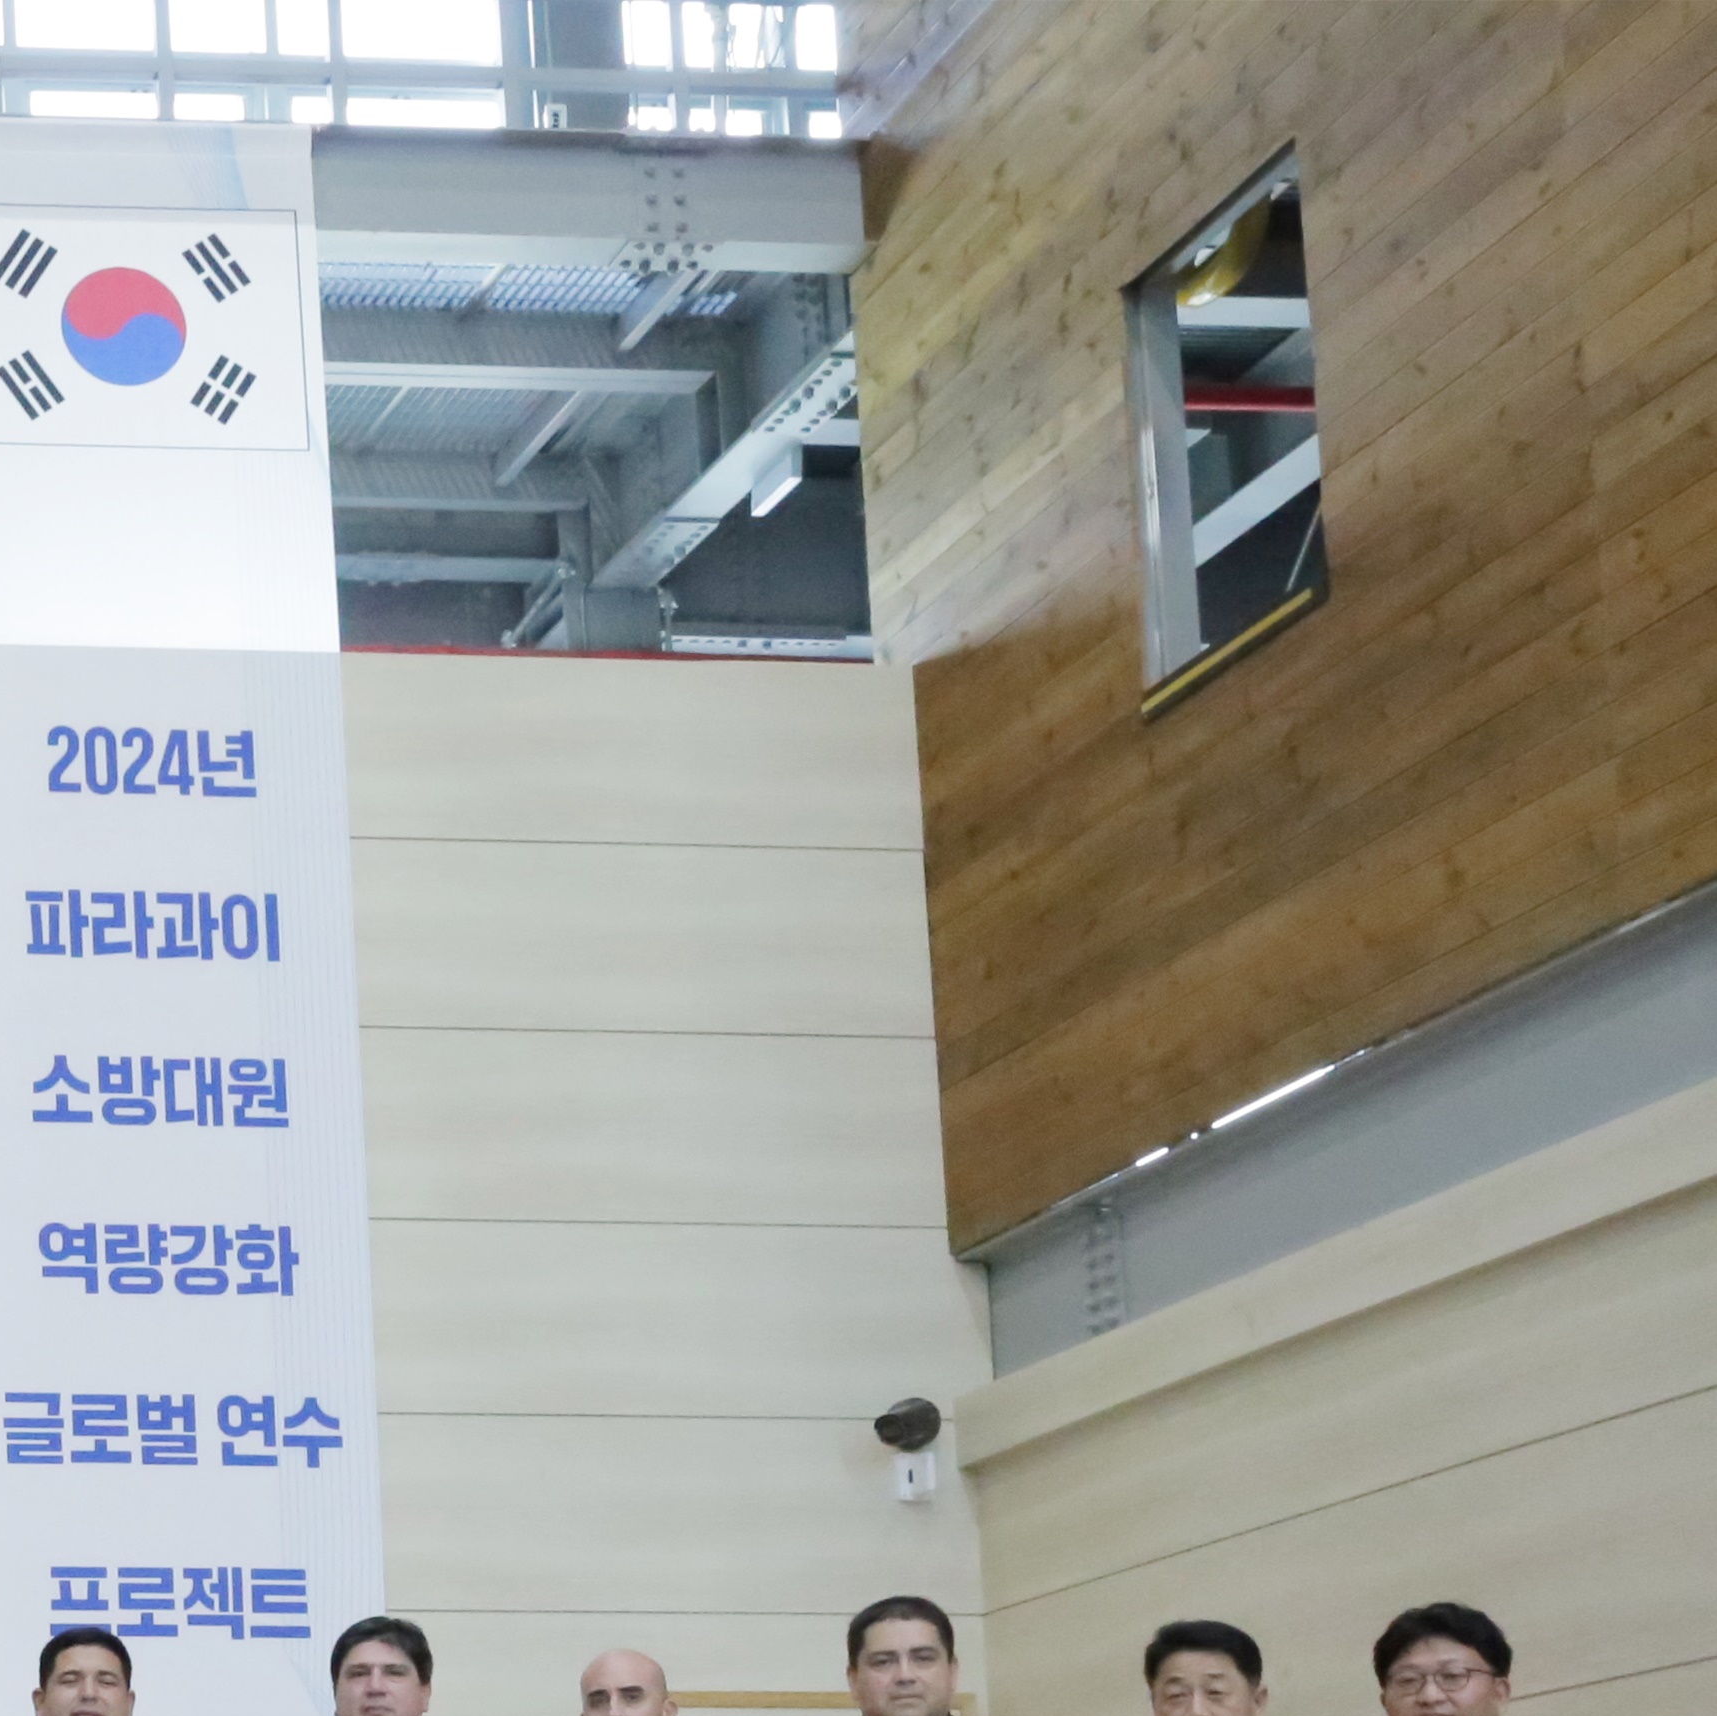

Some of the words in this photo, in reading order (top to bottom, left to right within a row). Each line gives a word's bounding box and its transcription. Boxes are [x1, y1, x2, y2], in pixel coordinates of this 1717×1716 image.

[48, 725, 257, 798] 2024년
[26, 889, 280, 962] 파라과이
[32, 1054, 290, 1128] 소방대원
[39, 1222, 299, 1297] 역량강화
[4, 1392, 198, 1466] 글로벌
[218, 1395, 343, 1469] 연수
[50, 1566, 312, 1640] 프로젝트
